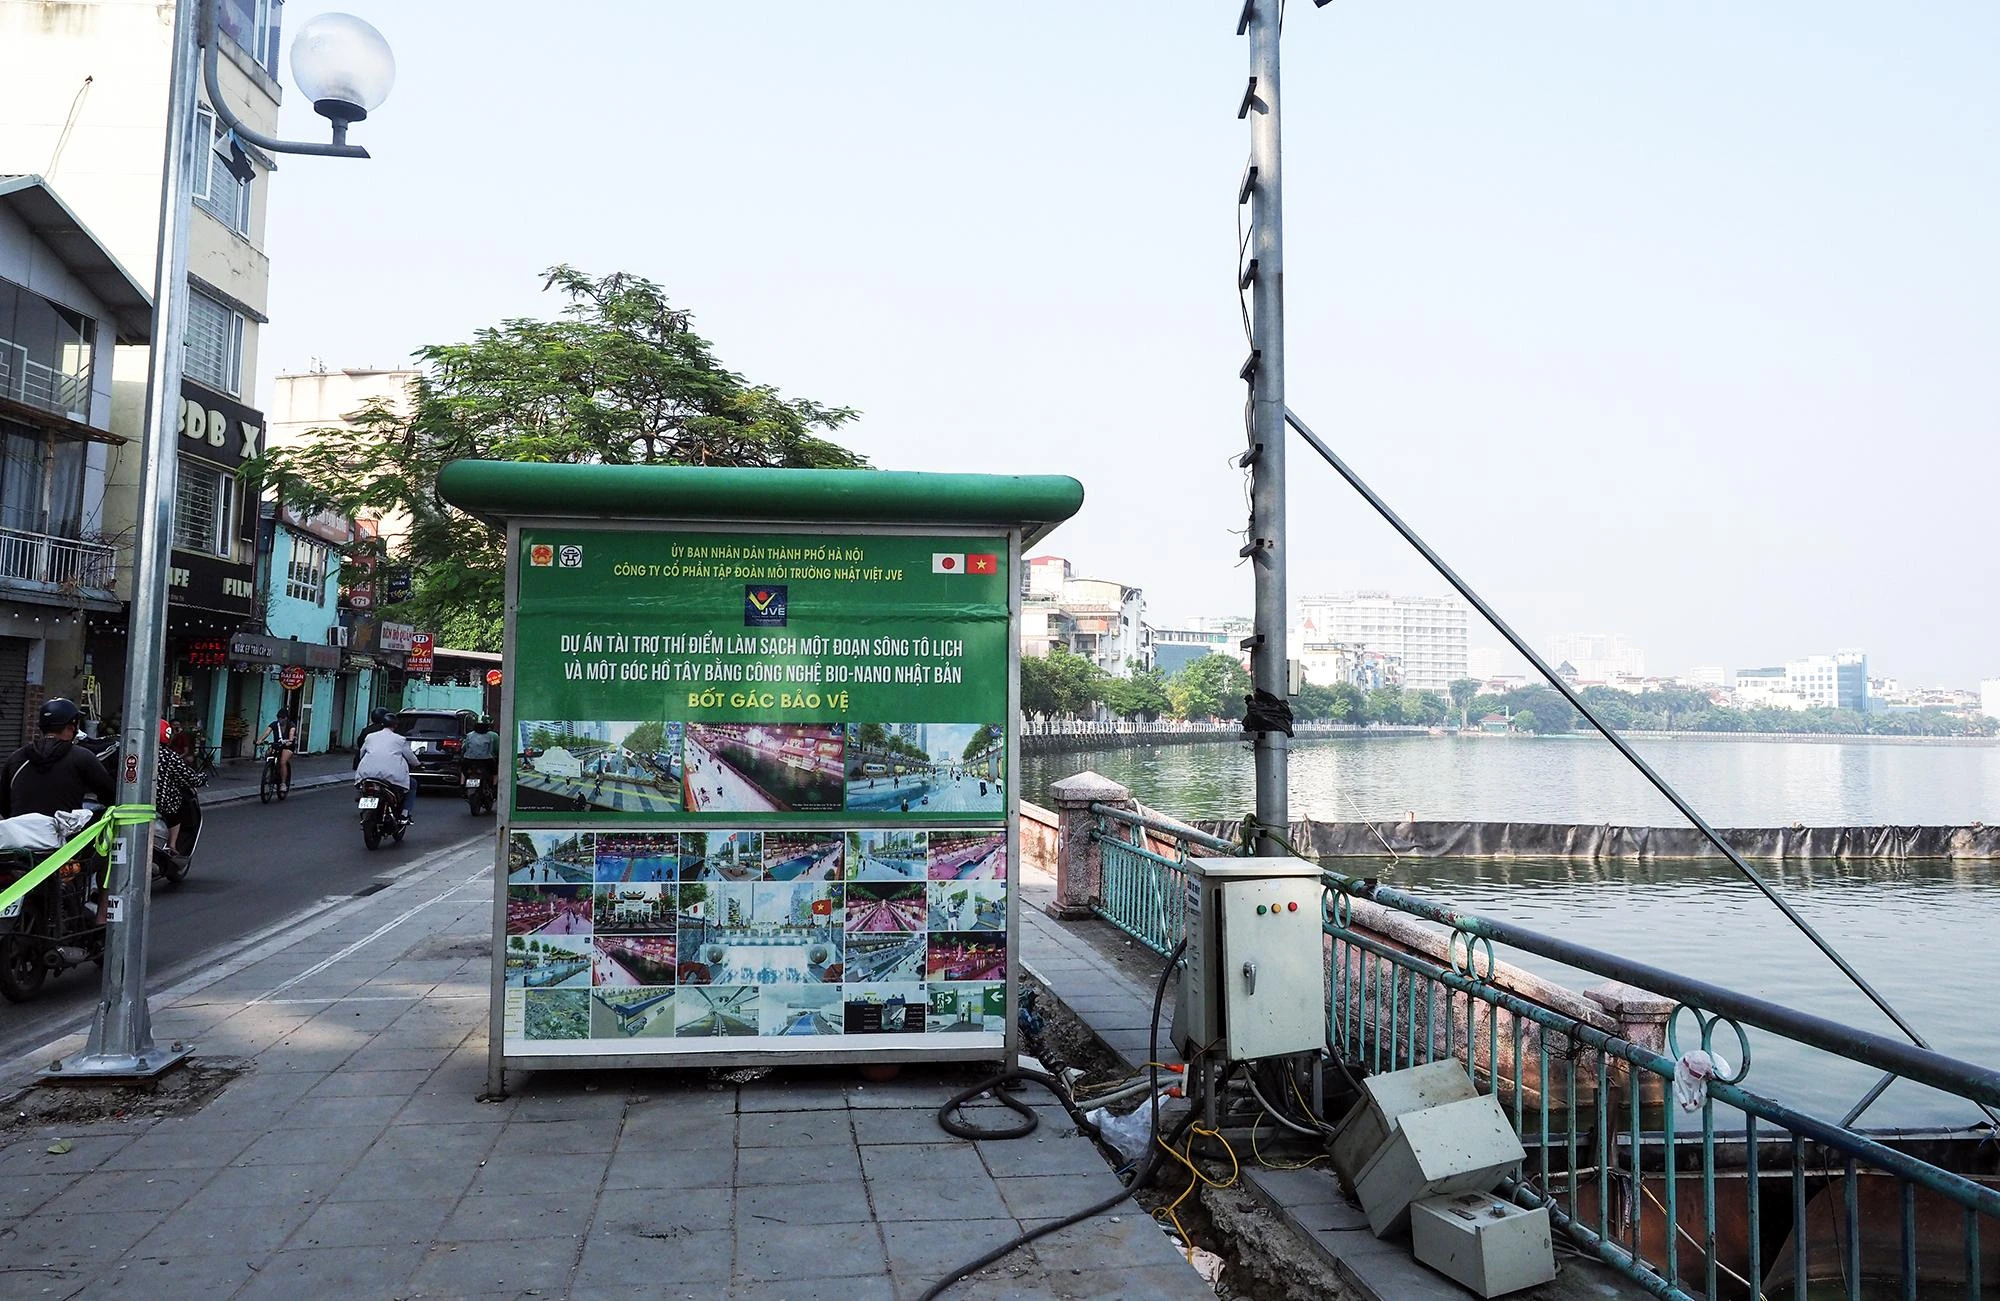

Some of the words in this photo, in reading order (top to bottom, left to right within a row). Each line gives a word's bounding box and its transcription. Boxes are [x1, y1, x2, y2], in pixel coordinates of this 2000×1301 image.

[671, 542, 685, 558] ỦY
[687, 546, 708, 559] BAN
[711, 545, 740, 559] NHÂN
[743, 545, 765, 560] DÂN
[767, 545, 801, 560] THÀNH
[804, 545, 826, 561] PHỐ
[828, 546, 843, 561] HÀ
[845, 547, 864, 564] NỘI
[614, 562, 646, 576] CÔNG
[649, 564, 660, 576] TY
[663, 560, 680, 577] CỔ
[682, 560, 711, 577] PHẦN
[714, 563, 732, 580] TẬP
[734, 563, 765, 578] ĐOÀN
[790, 565, 832, 580] TRƯỜNG
[834, 565, 860, 583] NHẬT
[863, 566, 883, 583] VIỆT
[885, 569, 903, 580] JVE
[223, 577, 253, 598] FILM
[353, 597, 368, 605] 171
[761, 606, 785, 616] JVE
[560, 634, 580, 655] DỰ
[583, 632, 603, 653] ÁN
[607, 632, 629, 654] TÀI
[633, 635, 660, 656] TRỢ
[662, 632, 685, 654] THÍ
[688, 630, 724, 654] ĐIỂM
[727, 633, 757, 655] LÀM
[760, 637, 796, 658] SẠCH
[800, 635, 830, 659] MỘT
[832, 638, 870, 659] ĐOẠN
[873, 636, 909, 657] SÔNG
[912, 636, 930, 657] TÔ
[933, 639, 963, 660] LỊCH
[564, 659, 583, 680] VÀ
[586, 659, 617, 683] MỘT
[620, 660, 648, 681] GÓC
[651, 658, 671, 681] HỒ
[674, 660, 701, 681] TÂY
[704, 657, 742, 682] BẰNG
[745, 661, 783, 682] CÔNG
[786, 662, 822, 686] NGHỆ
[825, 665, 891, 683] BIO-NANO
[894, 663, 931, 686] NHẬT
[934, 661, 962, 684] BẢN
[688, 686, 725, 708] BỐT
[730, 689, 775, 708] GÁC
[780, 688, 821, 709] BẢO
[826, 690, 849, 713] VỆ
